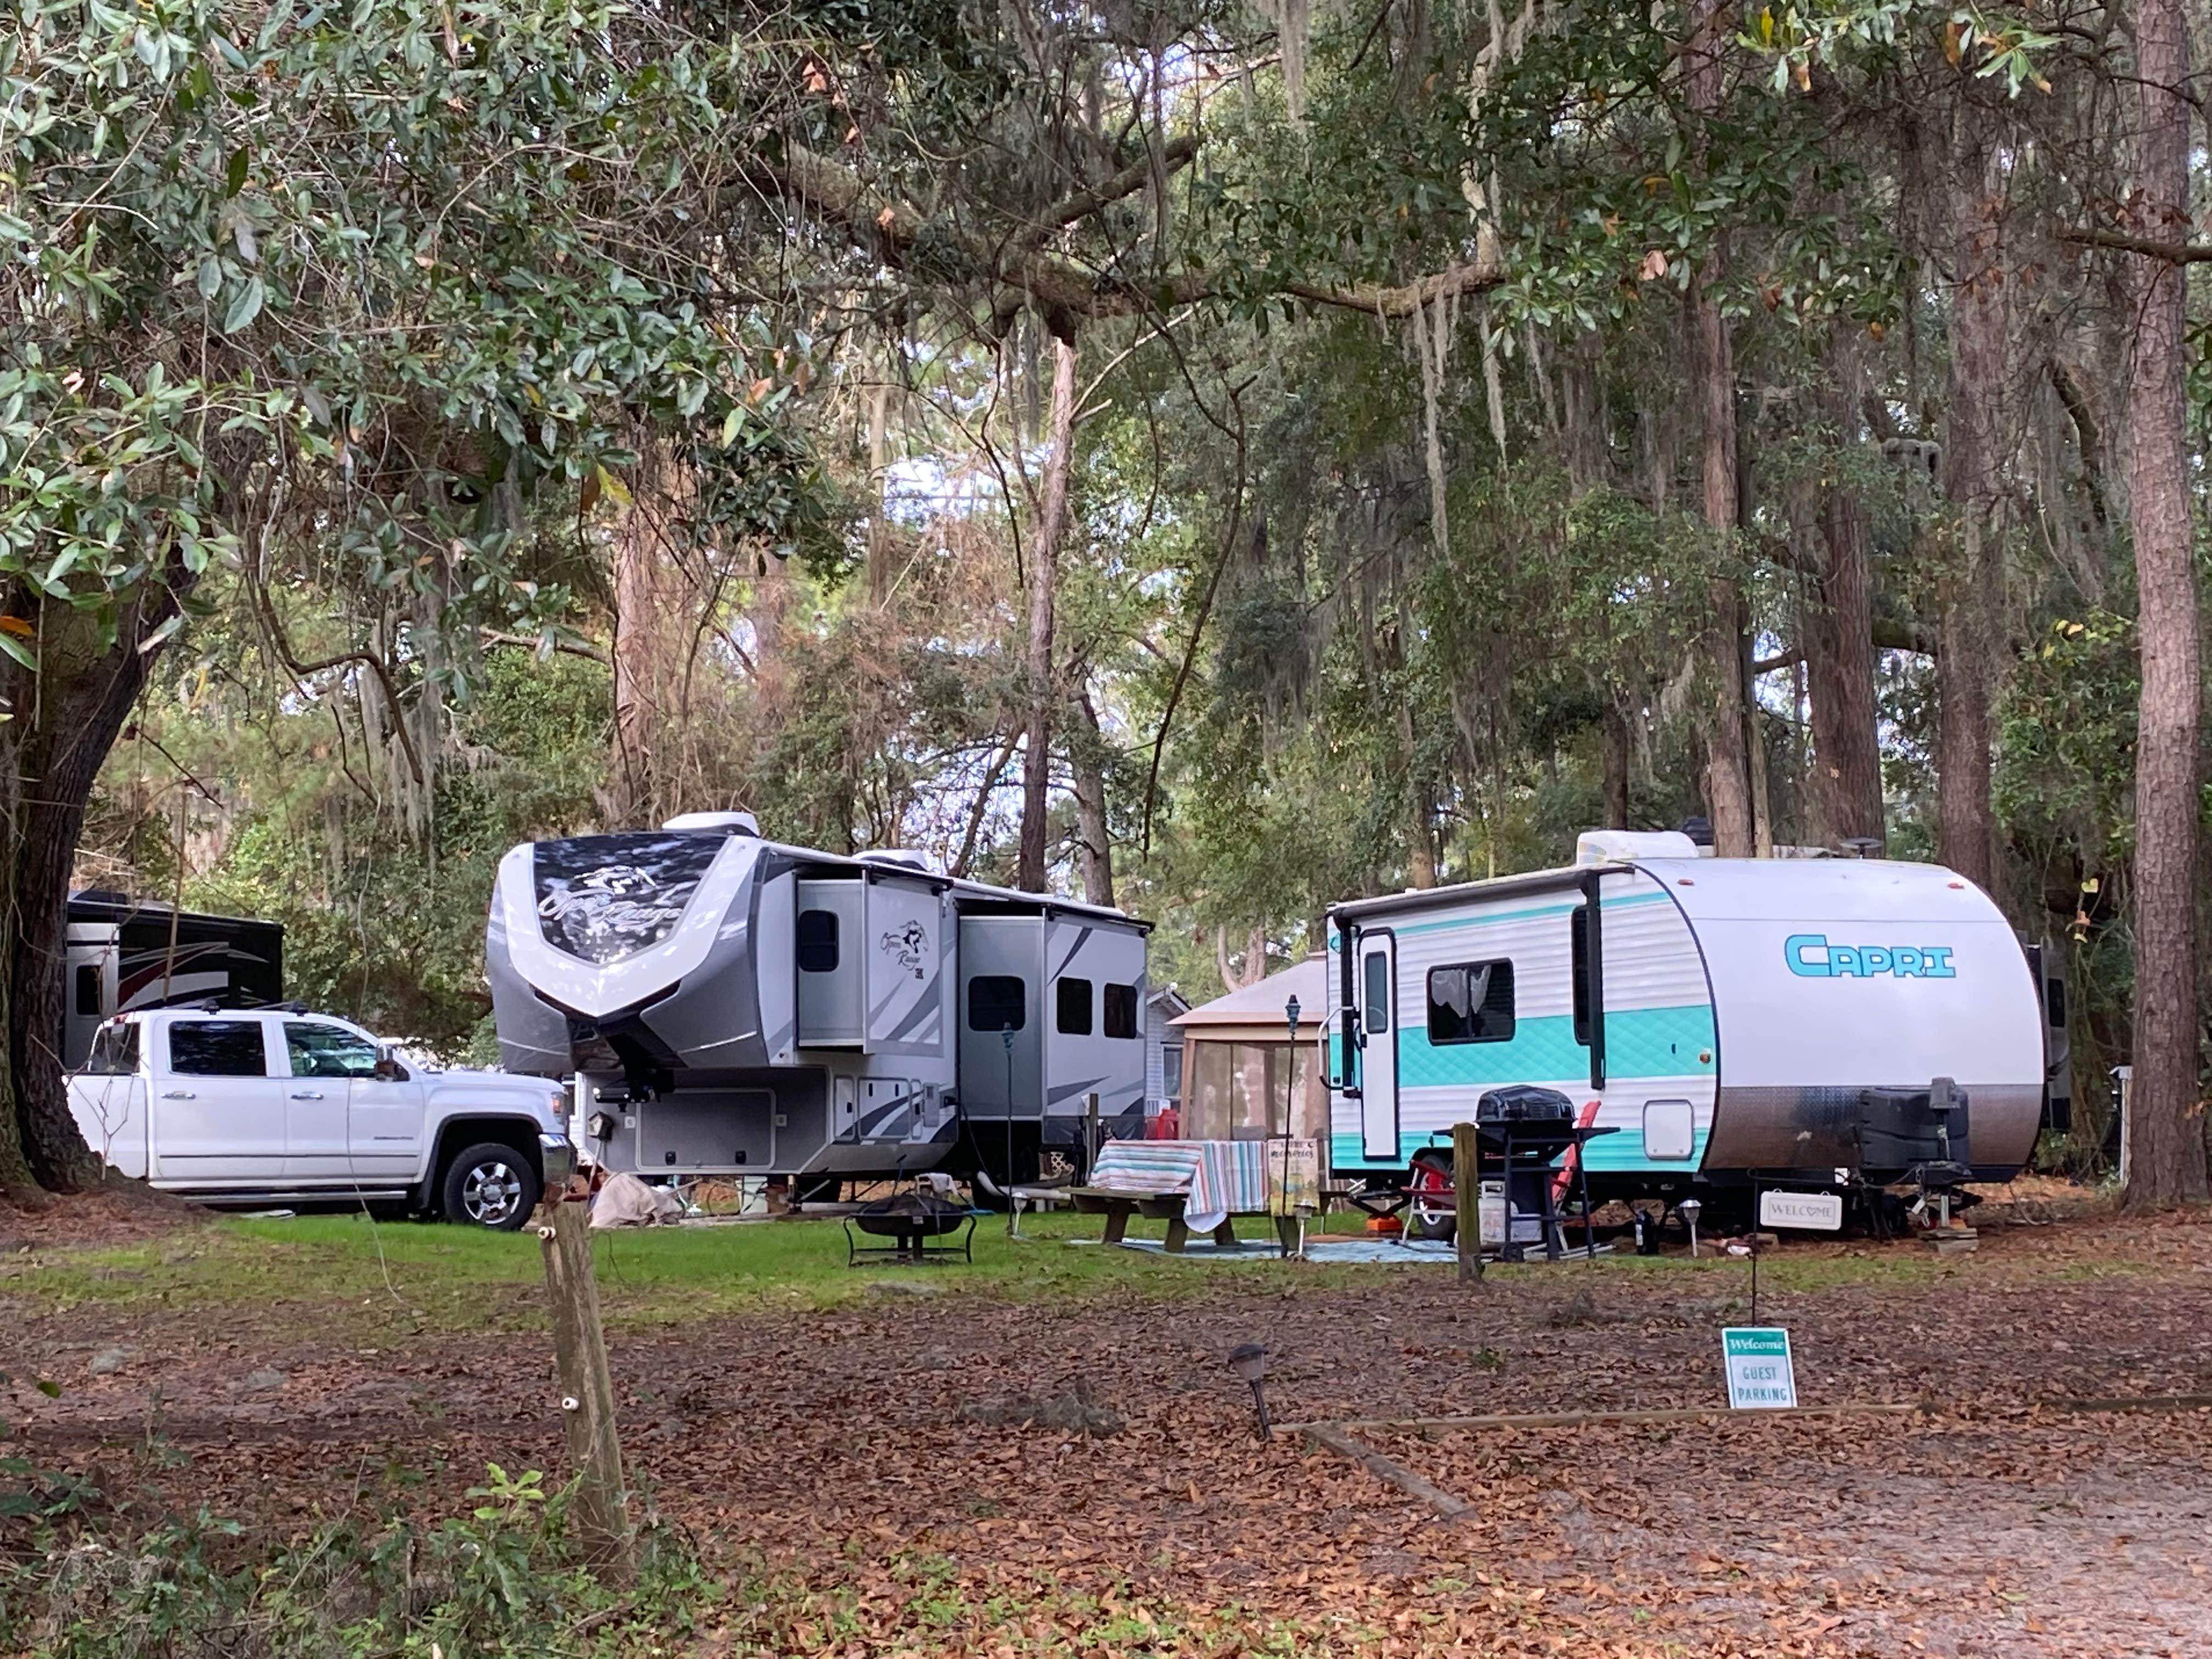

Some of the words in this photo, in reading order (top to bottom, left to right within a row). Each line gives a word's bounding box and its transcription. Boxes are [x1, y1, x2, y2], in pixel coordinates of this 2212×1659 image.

[1784, 934, 1956, 978] CAPRI
[1771, 1203, 1833, 1218] WELCOME
[1728, 1337, 1784, 1350] Welcome
[1742, 1367, 1776, 1380] GUEST
[1737, 1387, 1787, 1401] PARKING
